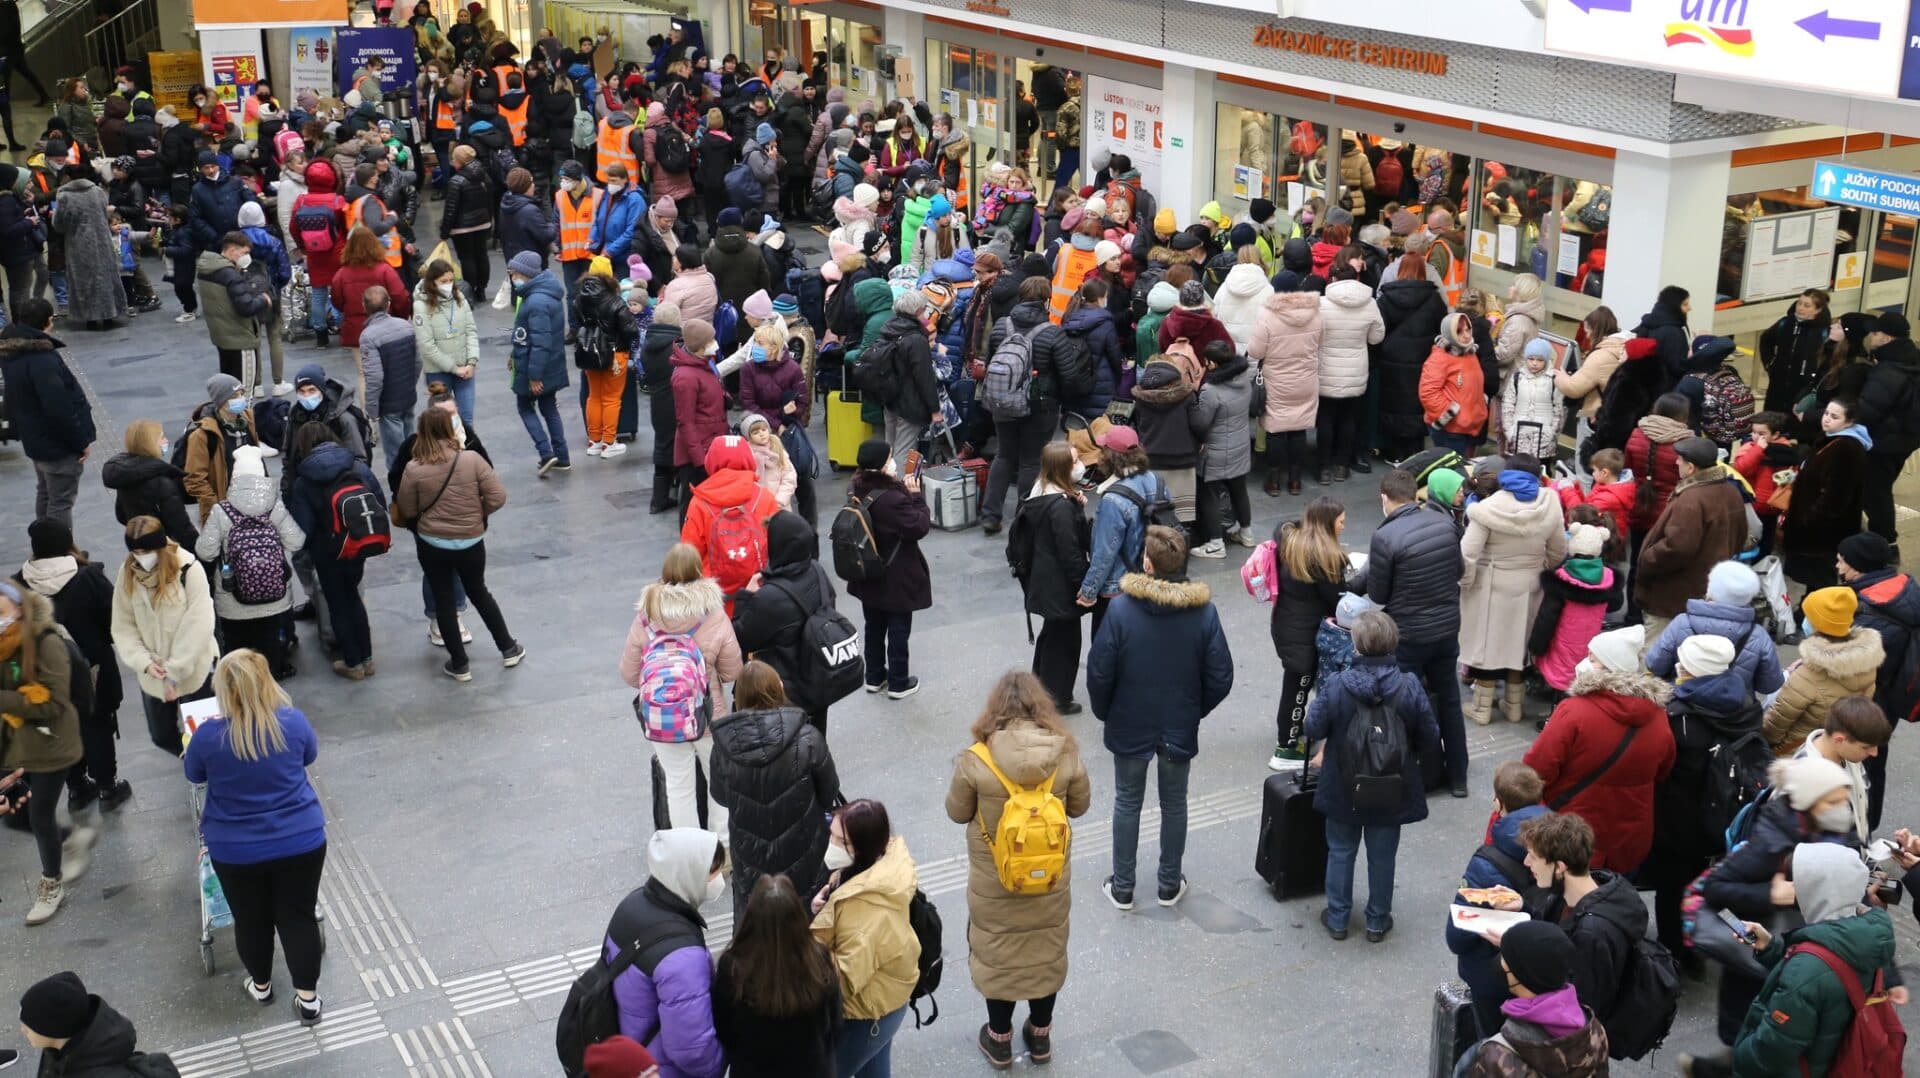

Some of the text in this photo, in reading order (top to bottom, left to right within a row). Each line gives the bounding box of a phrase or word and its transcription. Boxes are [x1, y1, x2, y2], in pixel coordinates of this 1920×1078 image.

[351, 57, 360, 65] ТА
[358, 48, 395, 57] ДОПОМОГА
[1253, 23, 1448, 76] ZÁKAZNÍCKE CENTRUM
[1145, 103, 1160, 115] 24/7
[1843, 173, 1920, 196] JUŽNÝ PODCH
[1841, 187, 1920, 211] SOUTH SUBWA
[821, 631, 859, 667] VAN
